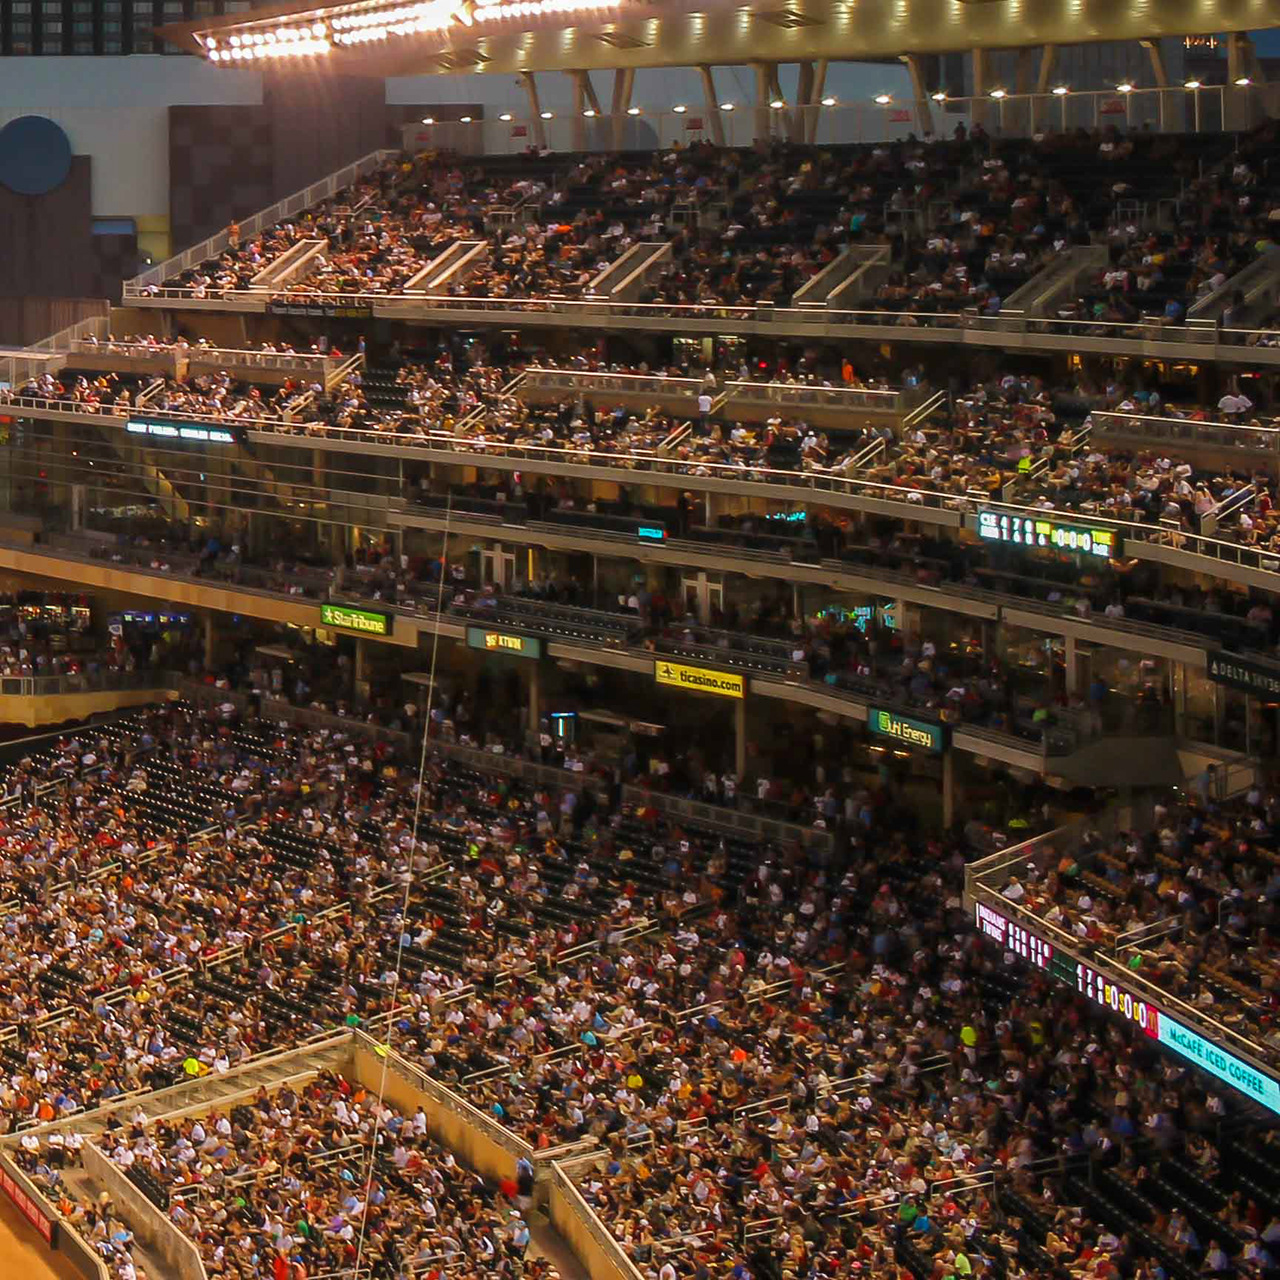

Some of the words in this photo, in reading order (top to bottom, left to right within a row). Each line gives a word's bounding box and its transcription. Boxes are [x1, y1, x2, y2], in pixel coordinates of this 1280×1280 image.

[680, 670, 741, 692] ticasino.com
[1205, 1046, 1227, 1071] ICED
[1228, 1062, 1265, 1095] COFFEE
